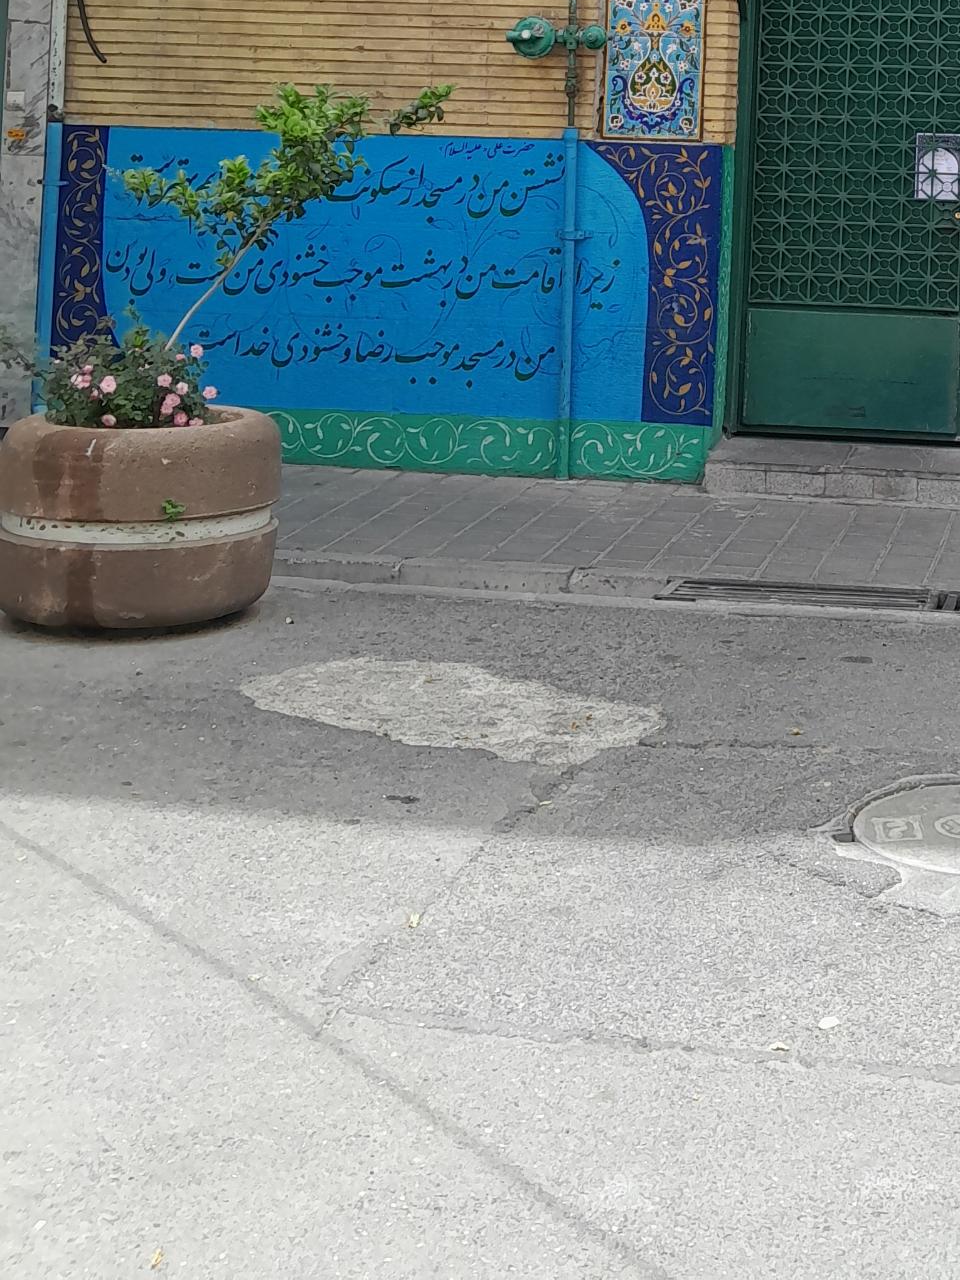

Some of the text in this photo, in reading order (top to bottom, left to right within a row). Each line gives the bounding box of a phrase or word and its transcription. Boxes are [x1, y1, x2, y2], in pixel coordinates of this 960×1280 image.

[487, 143, 503, 159] علی
[398, 161, 425, 206] از
[412, 176, 462, 224] مسجد
[454, 174, 480, 205] در
[467, 180, 509, 218] من
[500, 152, 566, 217] نشستن
[222, 258, 264, 296] من
[253, 244, 331, 295] خشنودی
[312, 264, 383, 304] موجب
[380, 249, 453, 308] بهشت
[441, 255, 468, 290] در
[455, 264, 496, 300] من
[491, 246, 563, 294] اقامت
[576, 259, 621, 310] زیرا
[270, 323, 349, 368] خشنودی
[339, 347, 351, 364] و
[356, 329, 393, 364] رضا
[395, 340, 460, 385] موجب
[450, 339, 505, 388] مسجد
[493, 350, 516, 369] در
[515, 345, 555, 382] من
